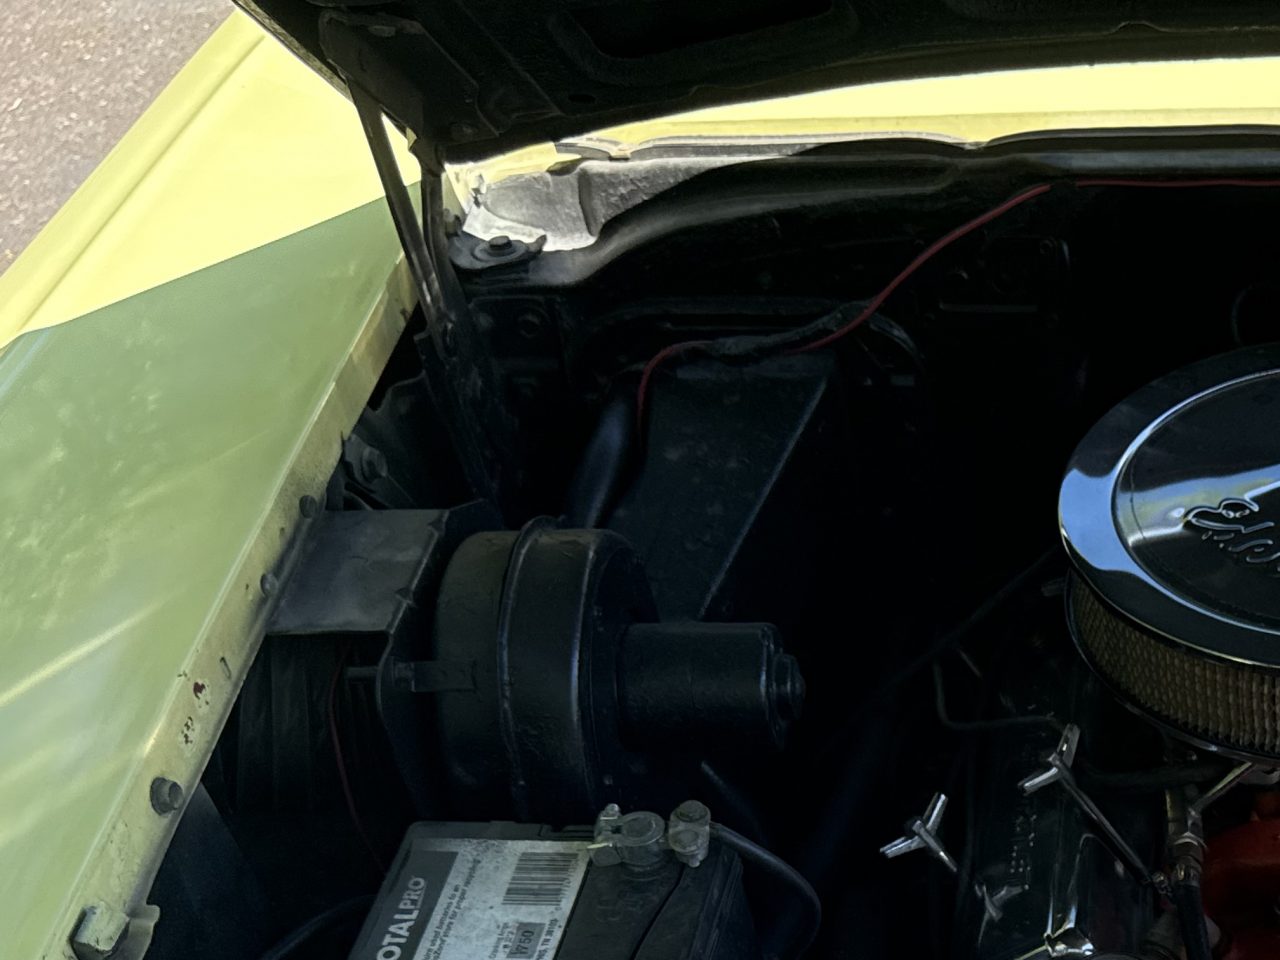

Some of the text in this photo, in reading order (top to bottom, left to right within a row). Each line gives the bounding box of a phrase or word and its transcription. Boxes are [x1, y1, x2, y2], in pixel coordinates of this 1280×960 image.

[452, 888, 469, 909] proper
[427, 930, 441, 946] used
[435, 901, 453, 929] batteries
[447, 910, 458, 919] for
